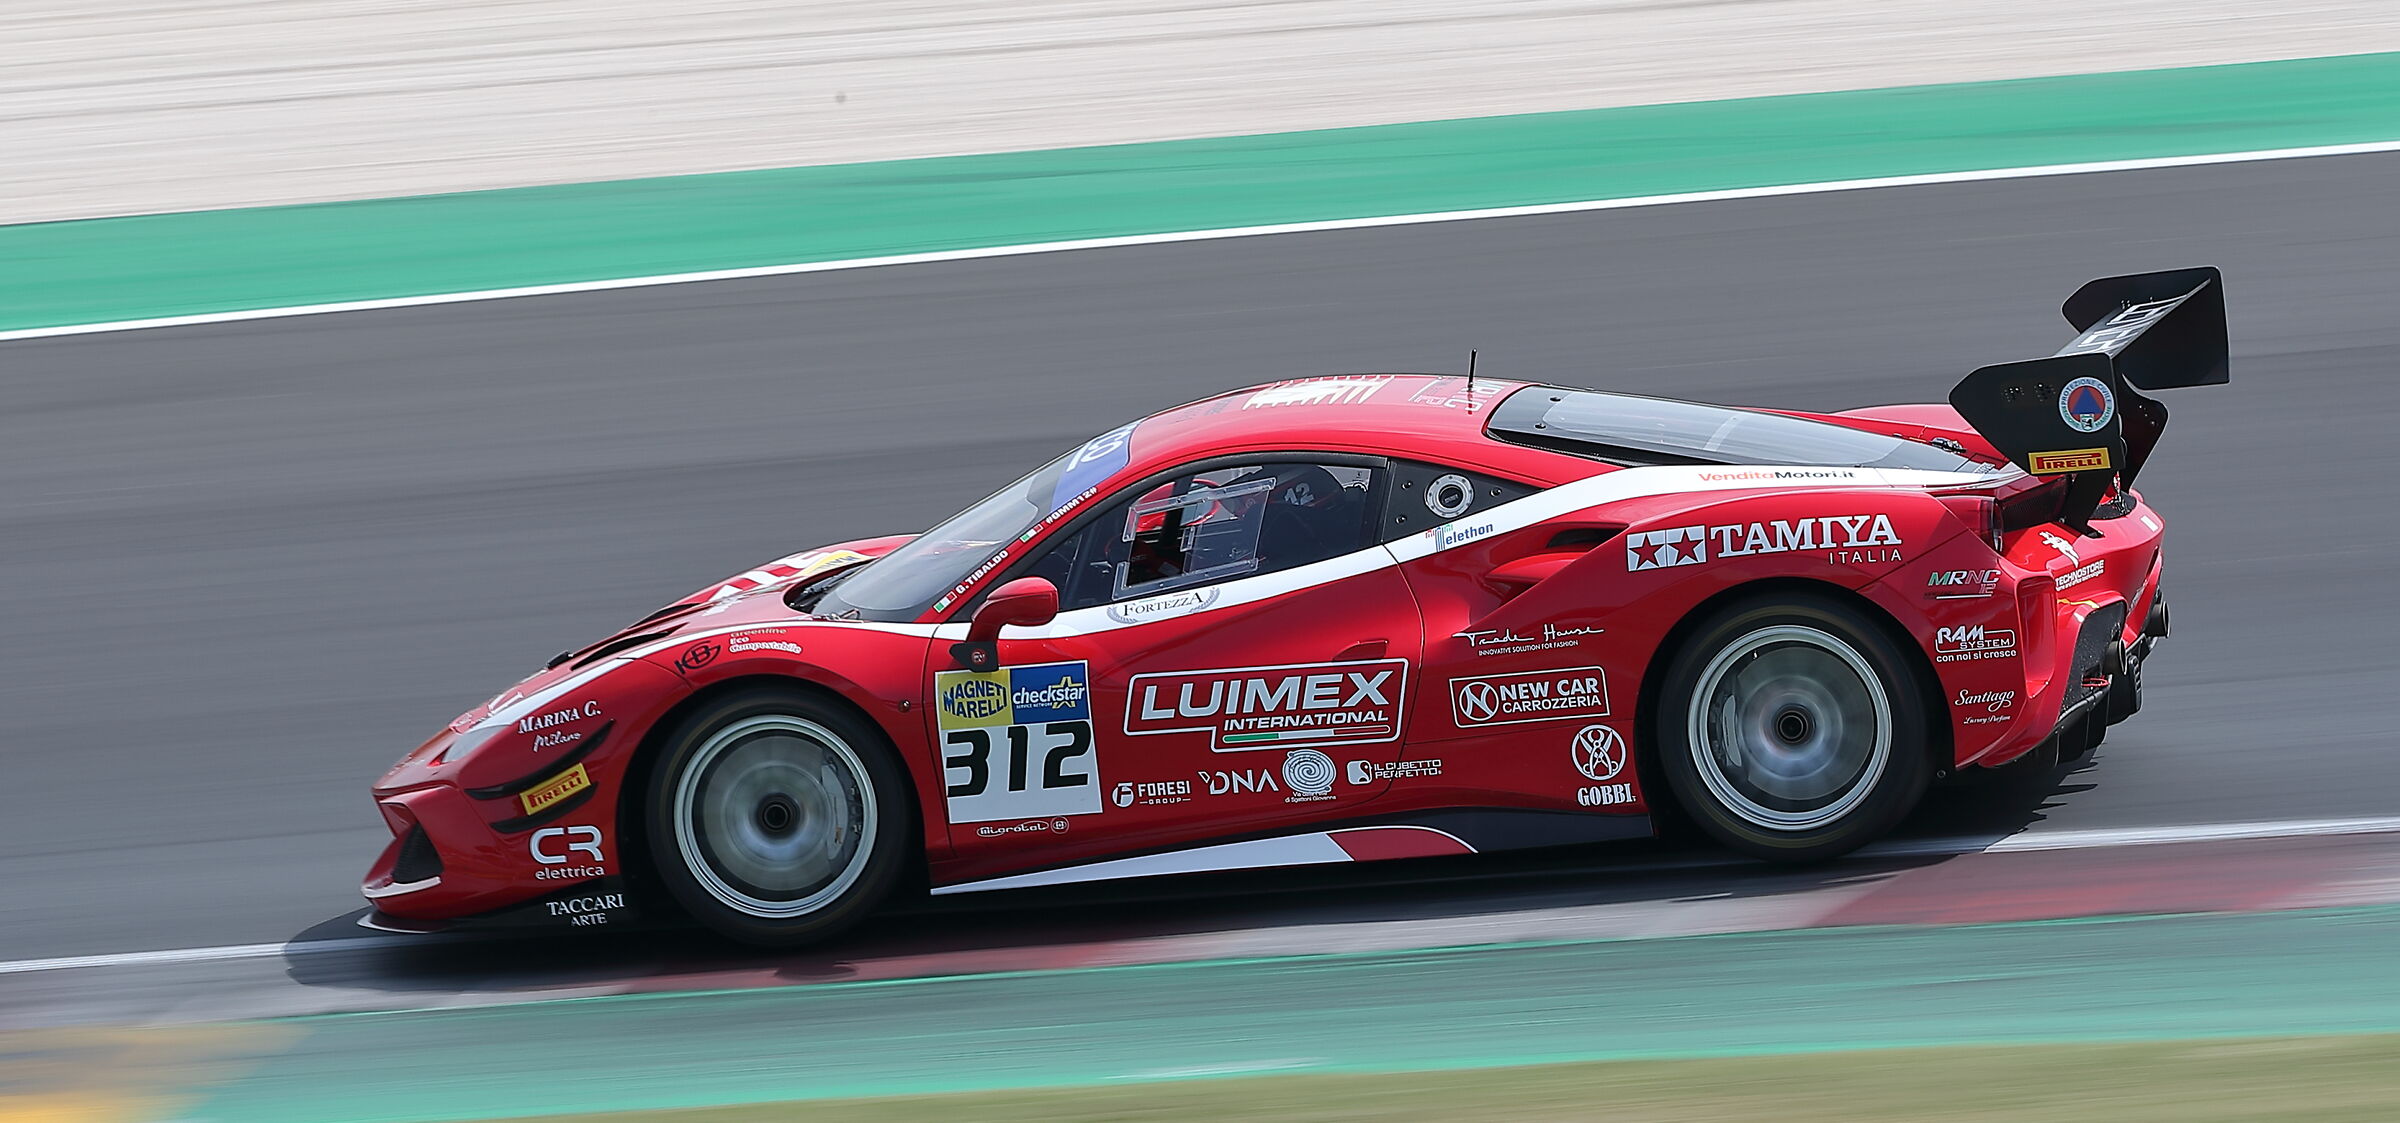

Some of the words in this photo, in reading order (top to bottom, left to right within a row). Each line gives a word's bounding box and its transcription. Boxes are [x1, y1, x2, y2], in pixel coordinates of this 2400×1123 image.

[2035, 452, 2102, 470] PIRELLI
[1698, 471, 1856, 481] VenditaMotori.it
[1709, 514, 1902, 558] TAMIYA
[1828, 550, 1902, 565] ITALIA
[956, 549, 1009, 595] G.TIBALDO
[1927, 569, 2002, 587] MRNC
[2054, 559, 2105, 587] TECHNOSTORE
[1123, 592, 1203, 616] FORTEZZA
[1543, 623, 1605, 642] House
[1937, 624, 1985, 645] RAM
[1478, 646, 1511, 656] INNOVATIVE
[1512, 643, 1541, 653] SOLUTION
[1541, 641, 1553, 650] FOR
[1553, 639, 1579, 649] FASHION
[1959, 638, 2010, 650] SYSTEM
[1936, 654, 1954, 663] con
[1956, 651, 1971, 661] noi
[1973, 650, 1982, 660] si
[1983, 649, 2017, 659] cresce
[943, 680, 1008, 702] MAGNETI
[1012, 685, 1086, 705] checkstar
[1141, 670, 1394, 721] LUIMEX
[1500, 681, 1550, 701] NEW
[1556, 677, 1600, 696] CAR
[1954, 688, 2015, 712] Santiago
[943, 696, 1008, 719] MARELLI
[1502, 694, 1602, 714] CARROZZERIA
[517, 707, 581, 734] MARINA
[1224, 710, 1390, 732] INTERNATIONAL
[532, 730, 582, 753] Milano
[945, 720, 1092, 798] 312
[1374, 763, 1385, 771] IL
[1385, 759, 1442, 771] CUBETTO
[526, 770, 583, 809] PIRELLI
[1137, 780, 1191, 798] FORESI
[1198, 768, 1279, 795] DNA
[1148, 797, 1182, 805] GROUP
[1577, 783, 1633, 807] GOBBI
[529, 825, 605, 865] CR
[534, 864, 605, 880] elettrica
[545, 893, 625, 916] TACCARI
[570, 912, 608, 927] ARTE
